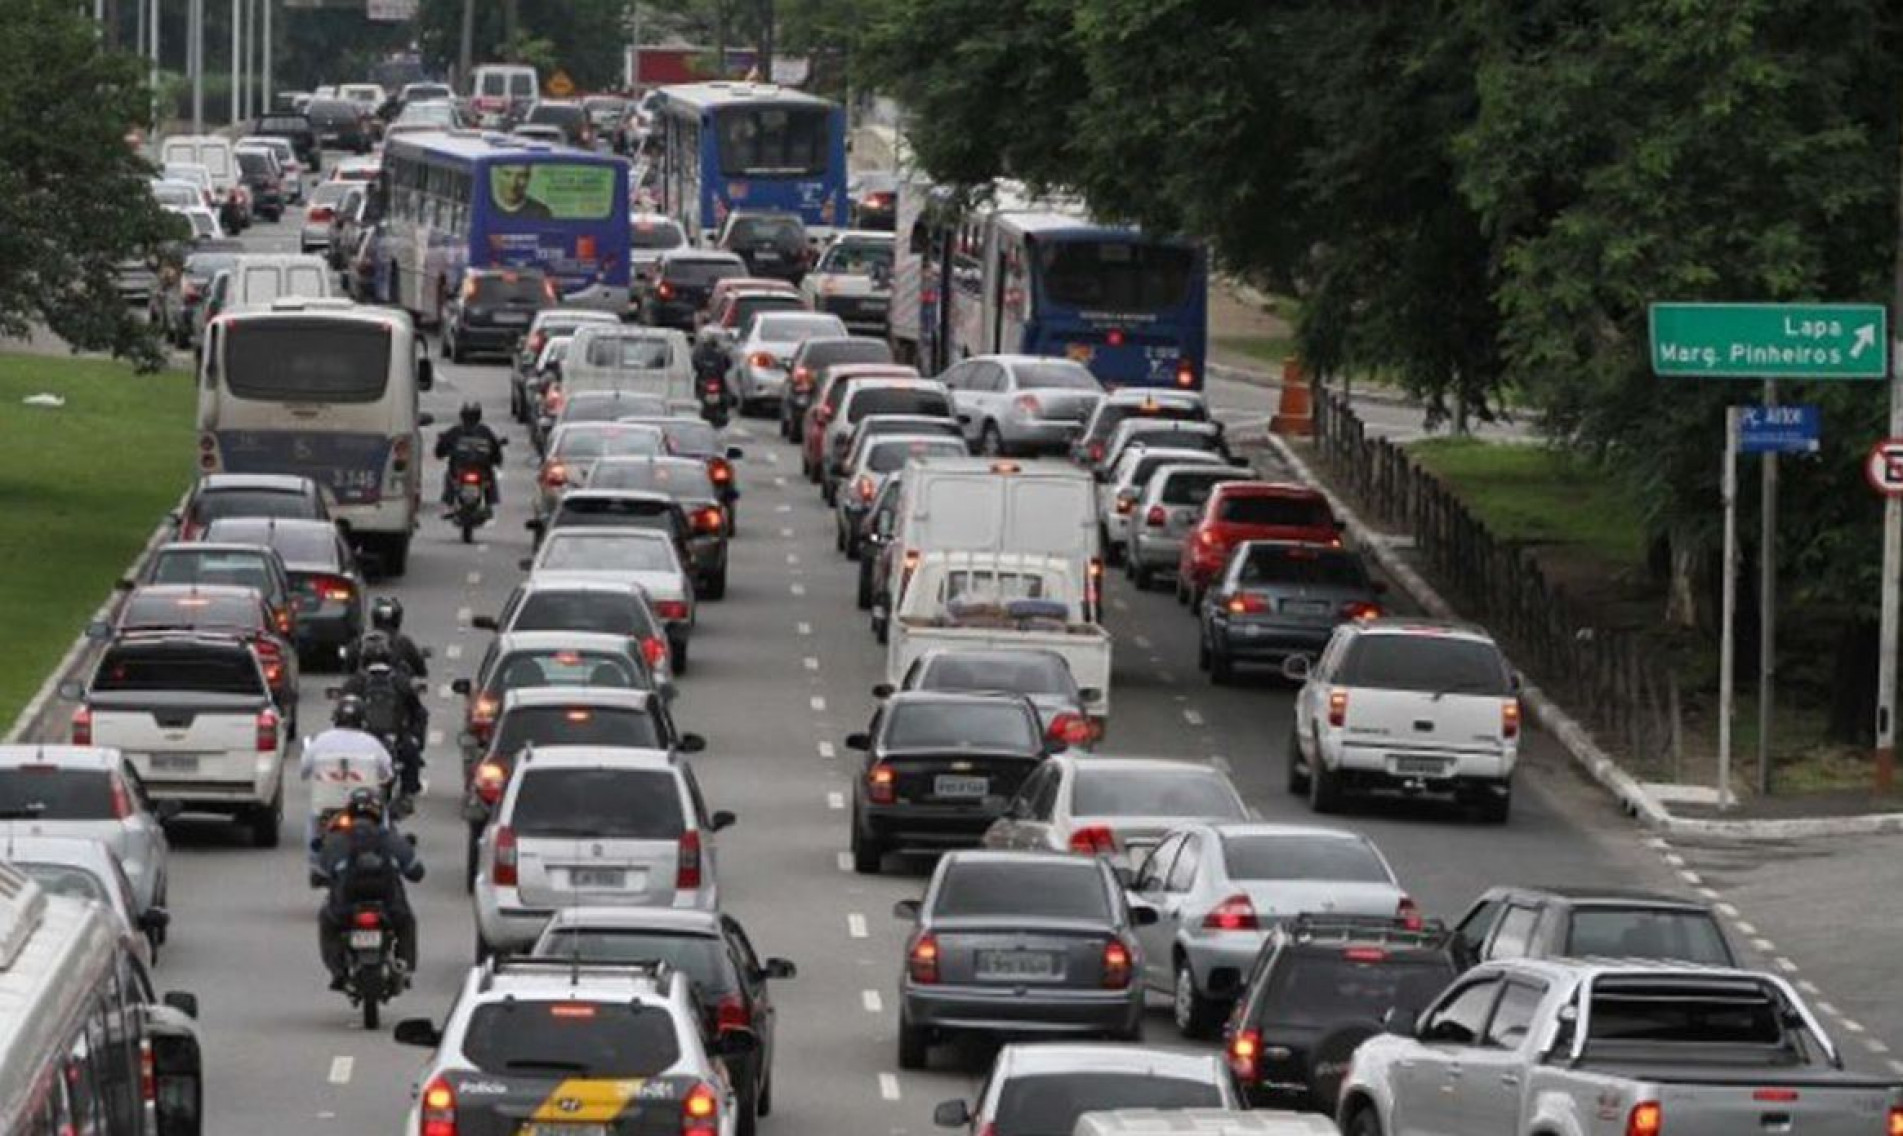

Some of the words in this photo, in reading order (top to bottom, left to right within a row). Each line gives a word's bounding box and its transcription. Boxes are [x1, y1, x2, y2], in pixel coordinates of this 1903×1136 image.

[1784, 315, 1842, 340] Lapa
[1660, 342, 1721, 367] Marg.
[1730, 343, 1842, 365] Pinheiros
